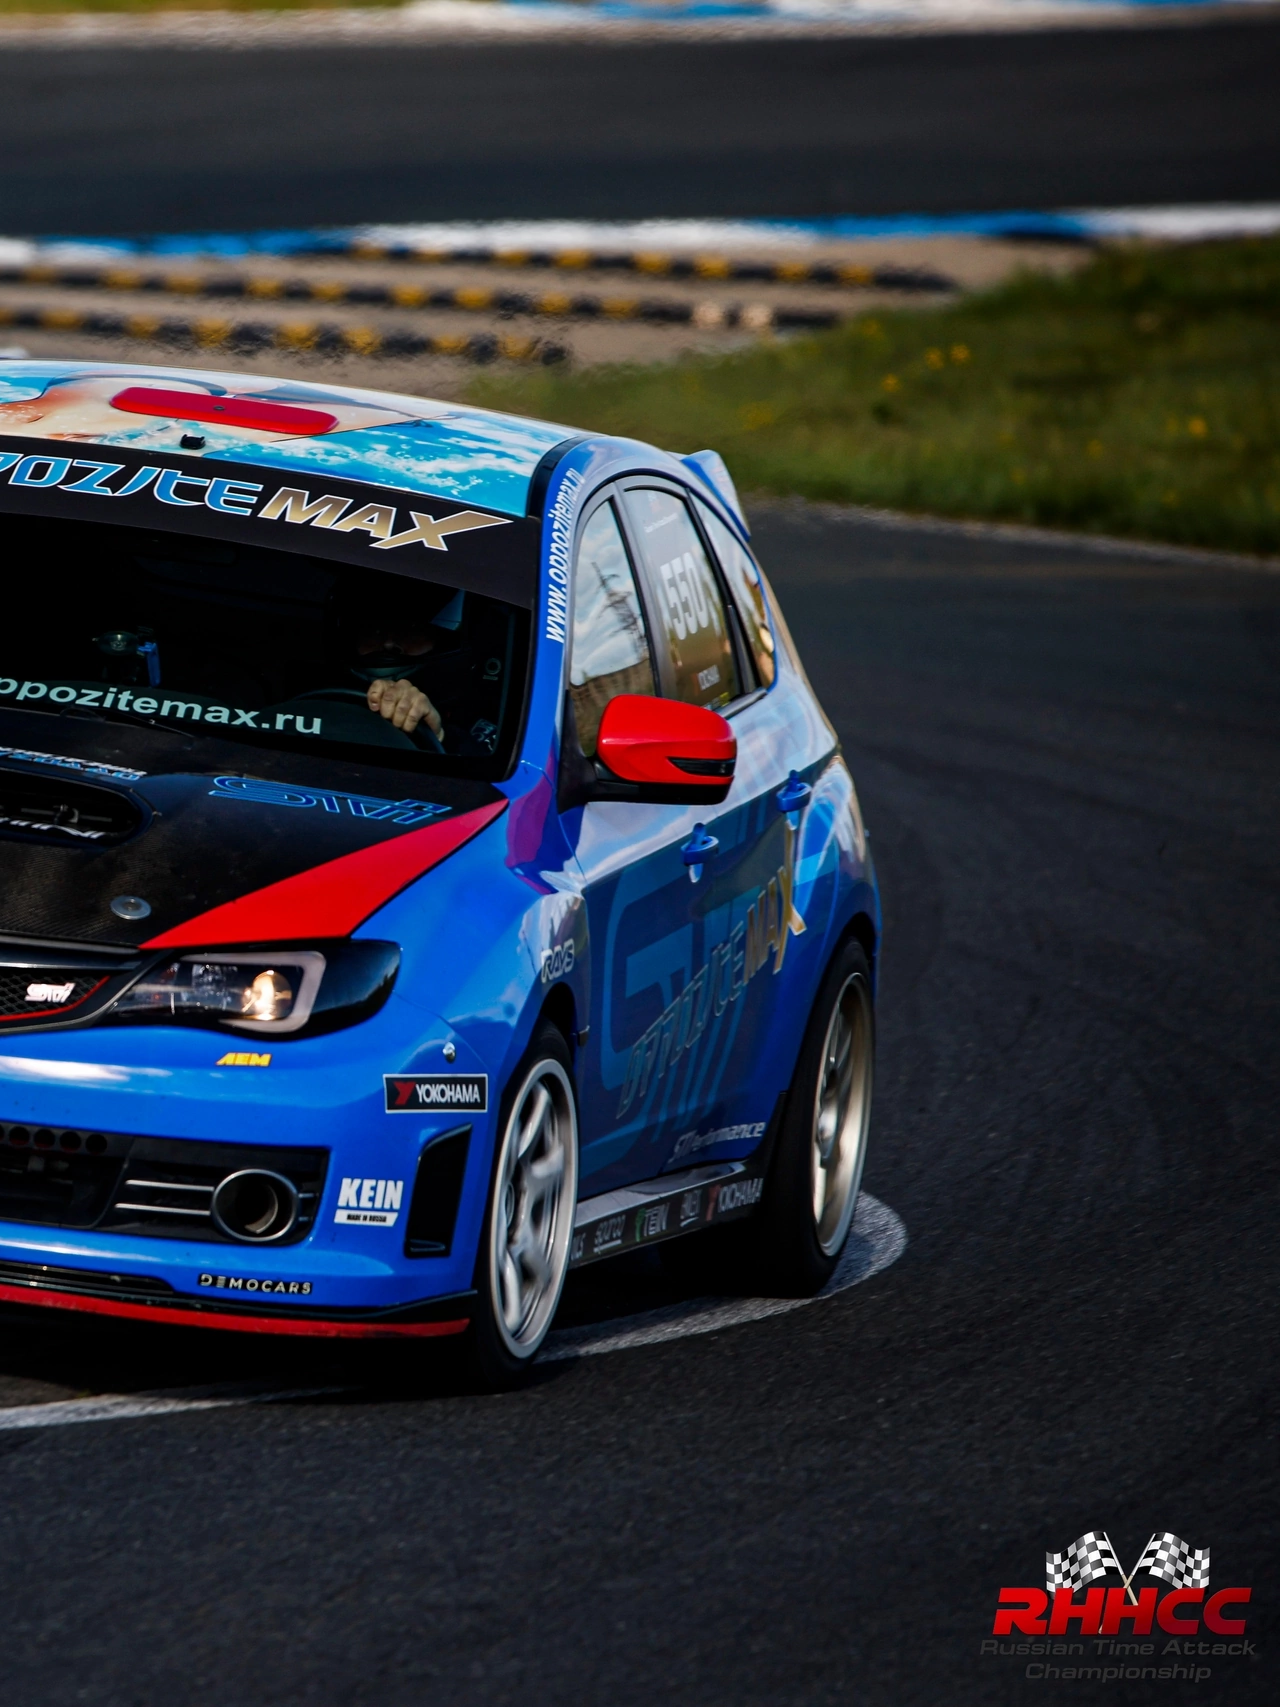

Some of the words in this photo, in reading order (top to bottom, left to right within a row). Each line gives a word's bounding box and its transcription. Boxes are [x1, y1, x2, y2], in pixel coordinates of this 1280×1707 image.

[545, 467, 586, 644] www.oppozitemax.ru
[659, 552, 709, 640] 550
[541, 937, 576, 984] RAYS
[215, 1052, 272, 1067] AEM
[415, 1083, 481, 1103] YOKOHAMA
[337, 1177, 404, 1210] KEIN
[200, 1273, 312, 1295] DEMOCARS
